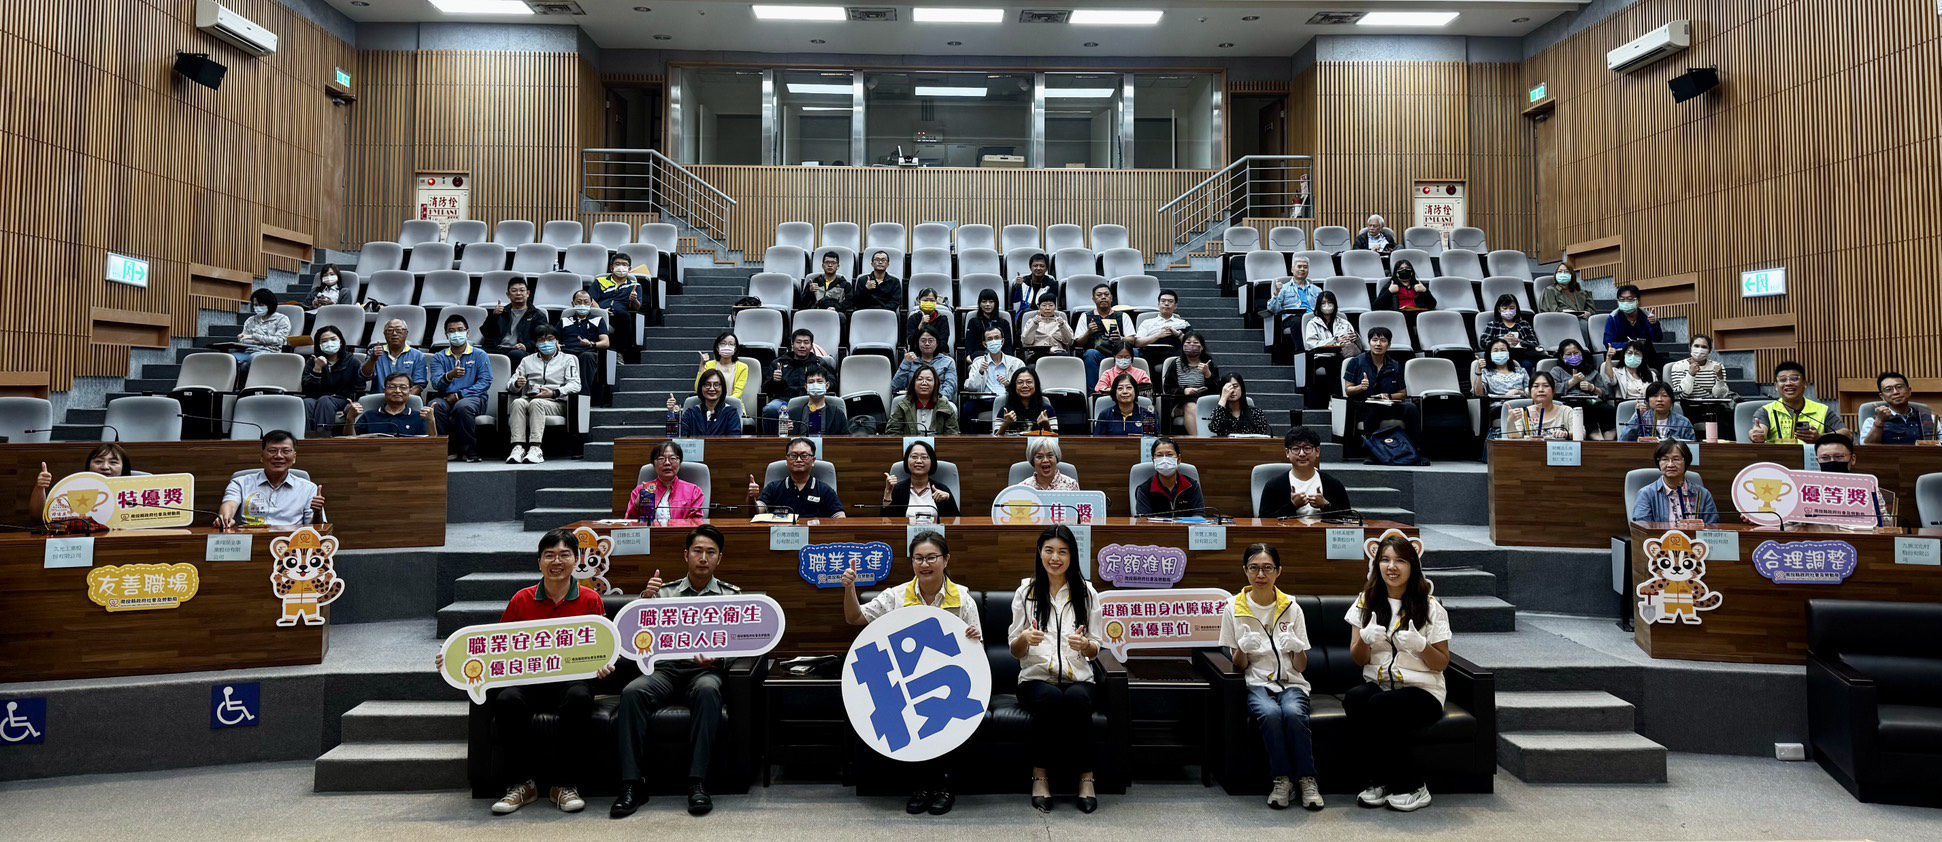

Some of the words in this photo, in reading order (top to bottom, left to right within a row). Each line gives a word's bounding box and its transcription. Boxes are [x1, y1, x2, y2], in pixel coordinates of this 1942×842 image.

[430, 196, 458, 208] 消防栓
[1425, 204, 1452, 215] 消防栓
[118, 488, 183, 509] 特優獎
[1801, 485, 1869, 506] 優等獎
[808, 550, 883, 572] 職業重建
[1106, 553, 1178, 575] 定額進用
[1763, 549, 1847, 571] 合理調整
[98, 573, 189, 597] 友善職場
[640, 605, 762, 627] 職業安全衛生
[1102, 601, 1228, 617] 超額進用身心障礙者
[1130, 621, 1190, 637] 績優單位
[468, 627, 596, 655] 職業安全衛生
[659, 632, 727, 649] 優良人員
[490, 656, 562, 677] 優良單位
[851, 616, 984, 753] 投
